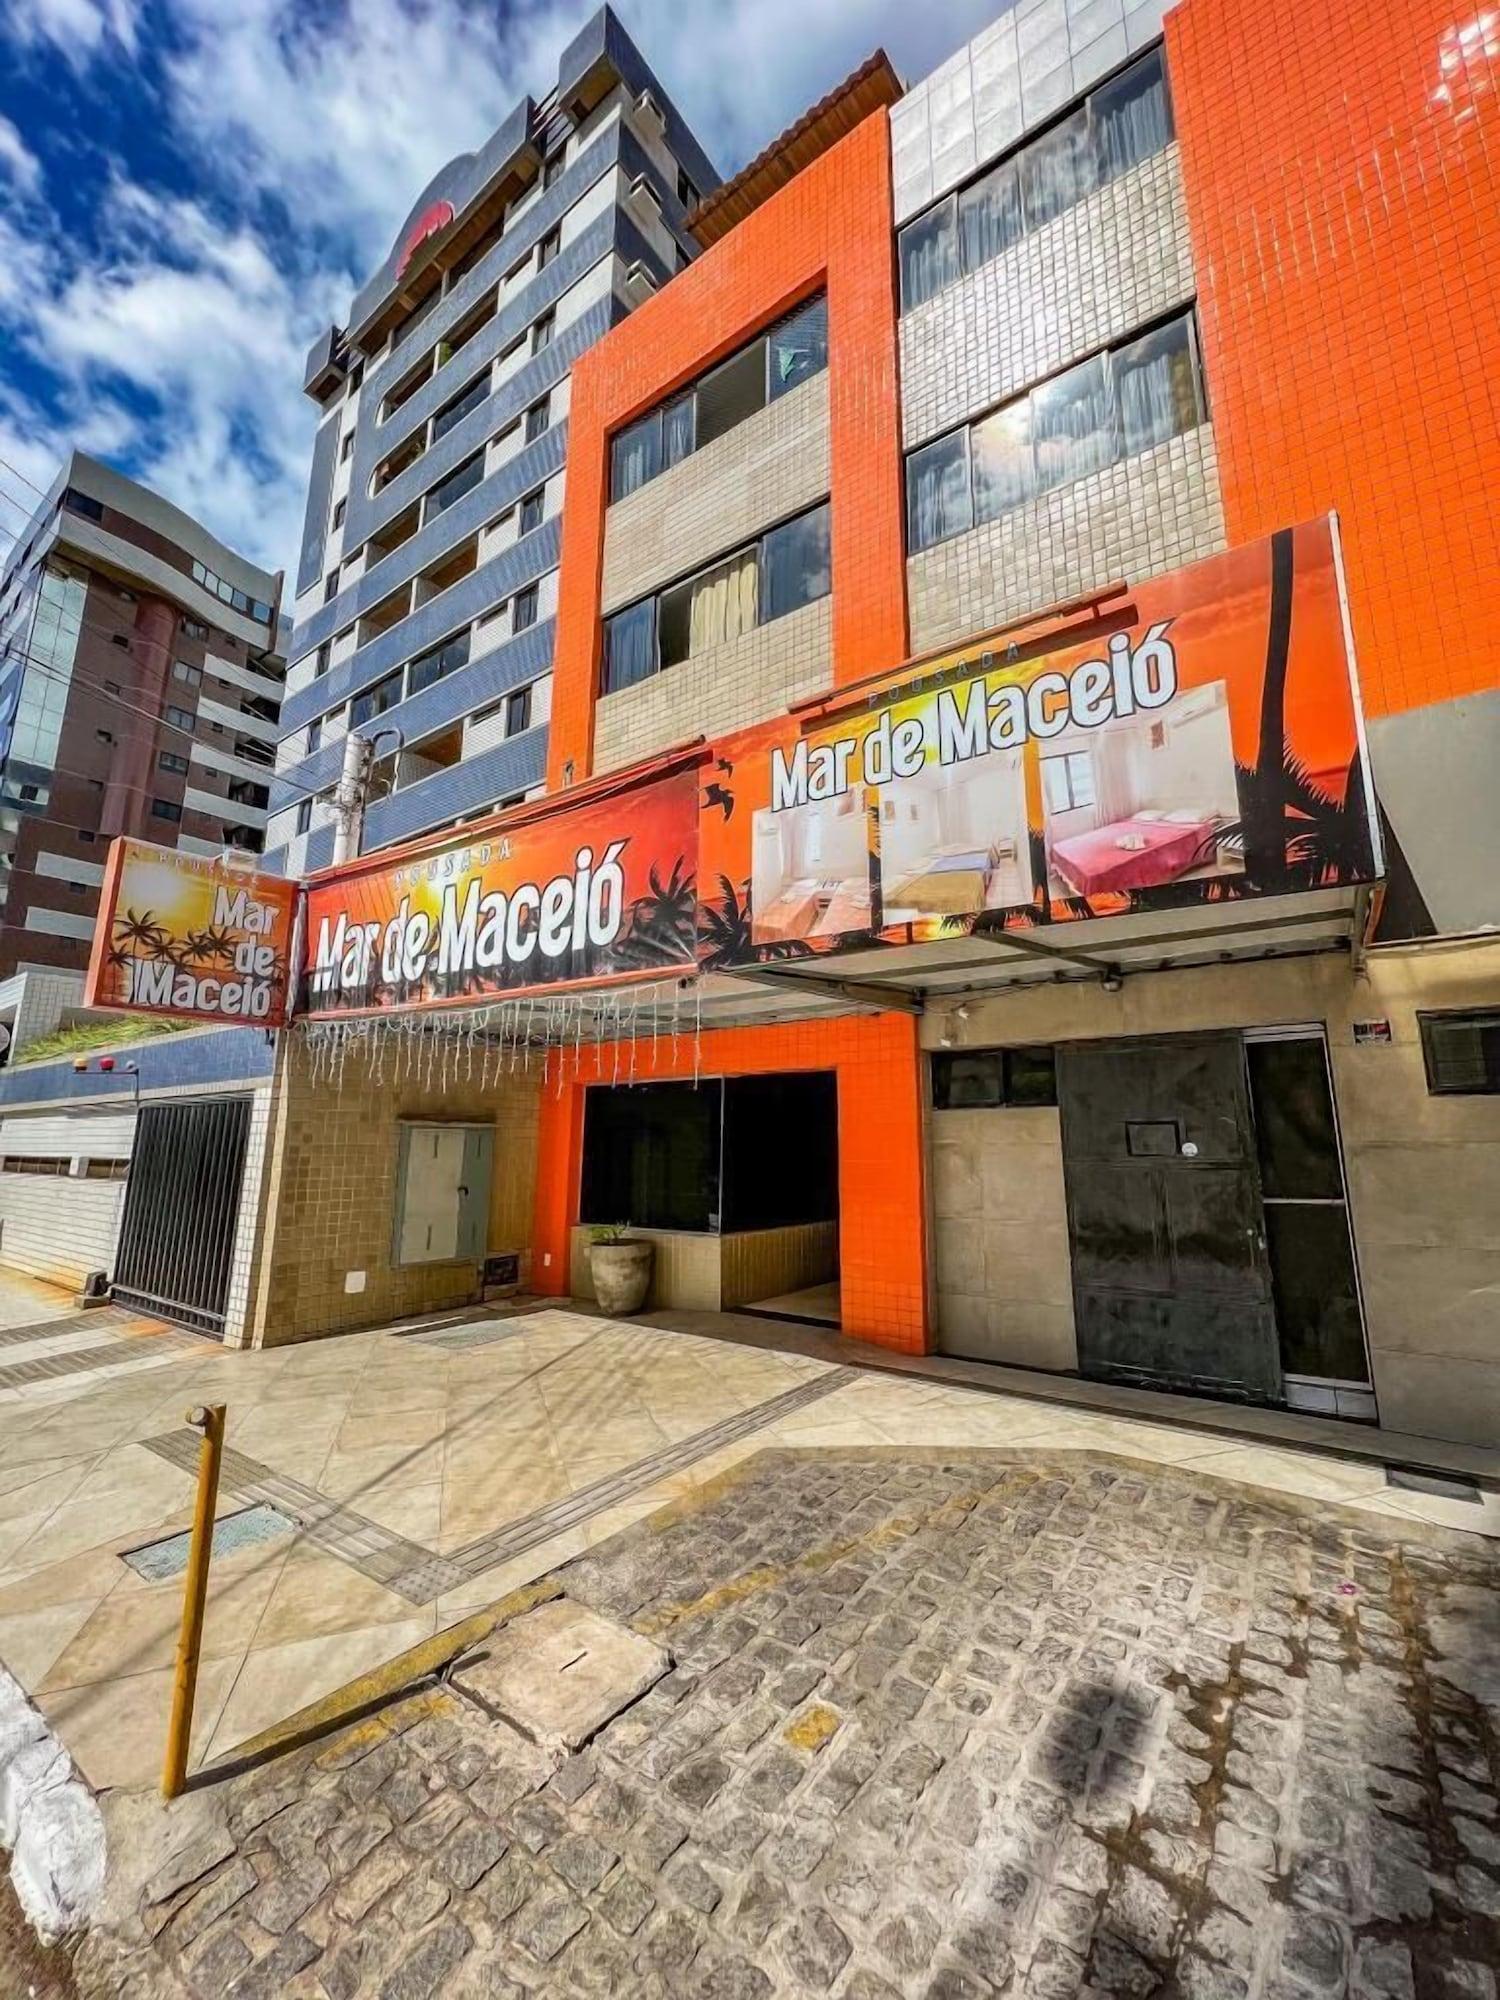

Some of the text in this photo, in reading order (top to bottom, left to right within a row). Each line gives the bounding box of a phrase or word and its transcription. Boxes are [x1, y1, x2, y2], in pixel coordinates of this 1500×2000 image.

[867, 641, 1020, 709] POUSADA
[771, 619, 1177, 813] Mar de Maceió
[394, 837, 512, 888] POUSADA
[214, 885, 280, 935] Mar
[312, 837, 631, 993] Mar de Maceió
[234, 931, 276, 977] de
[134, 958, 272, 1018] Maceió
